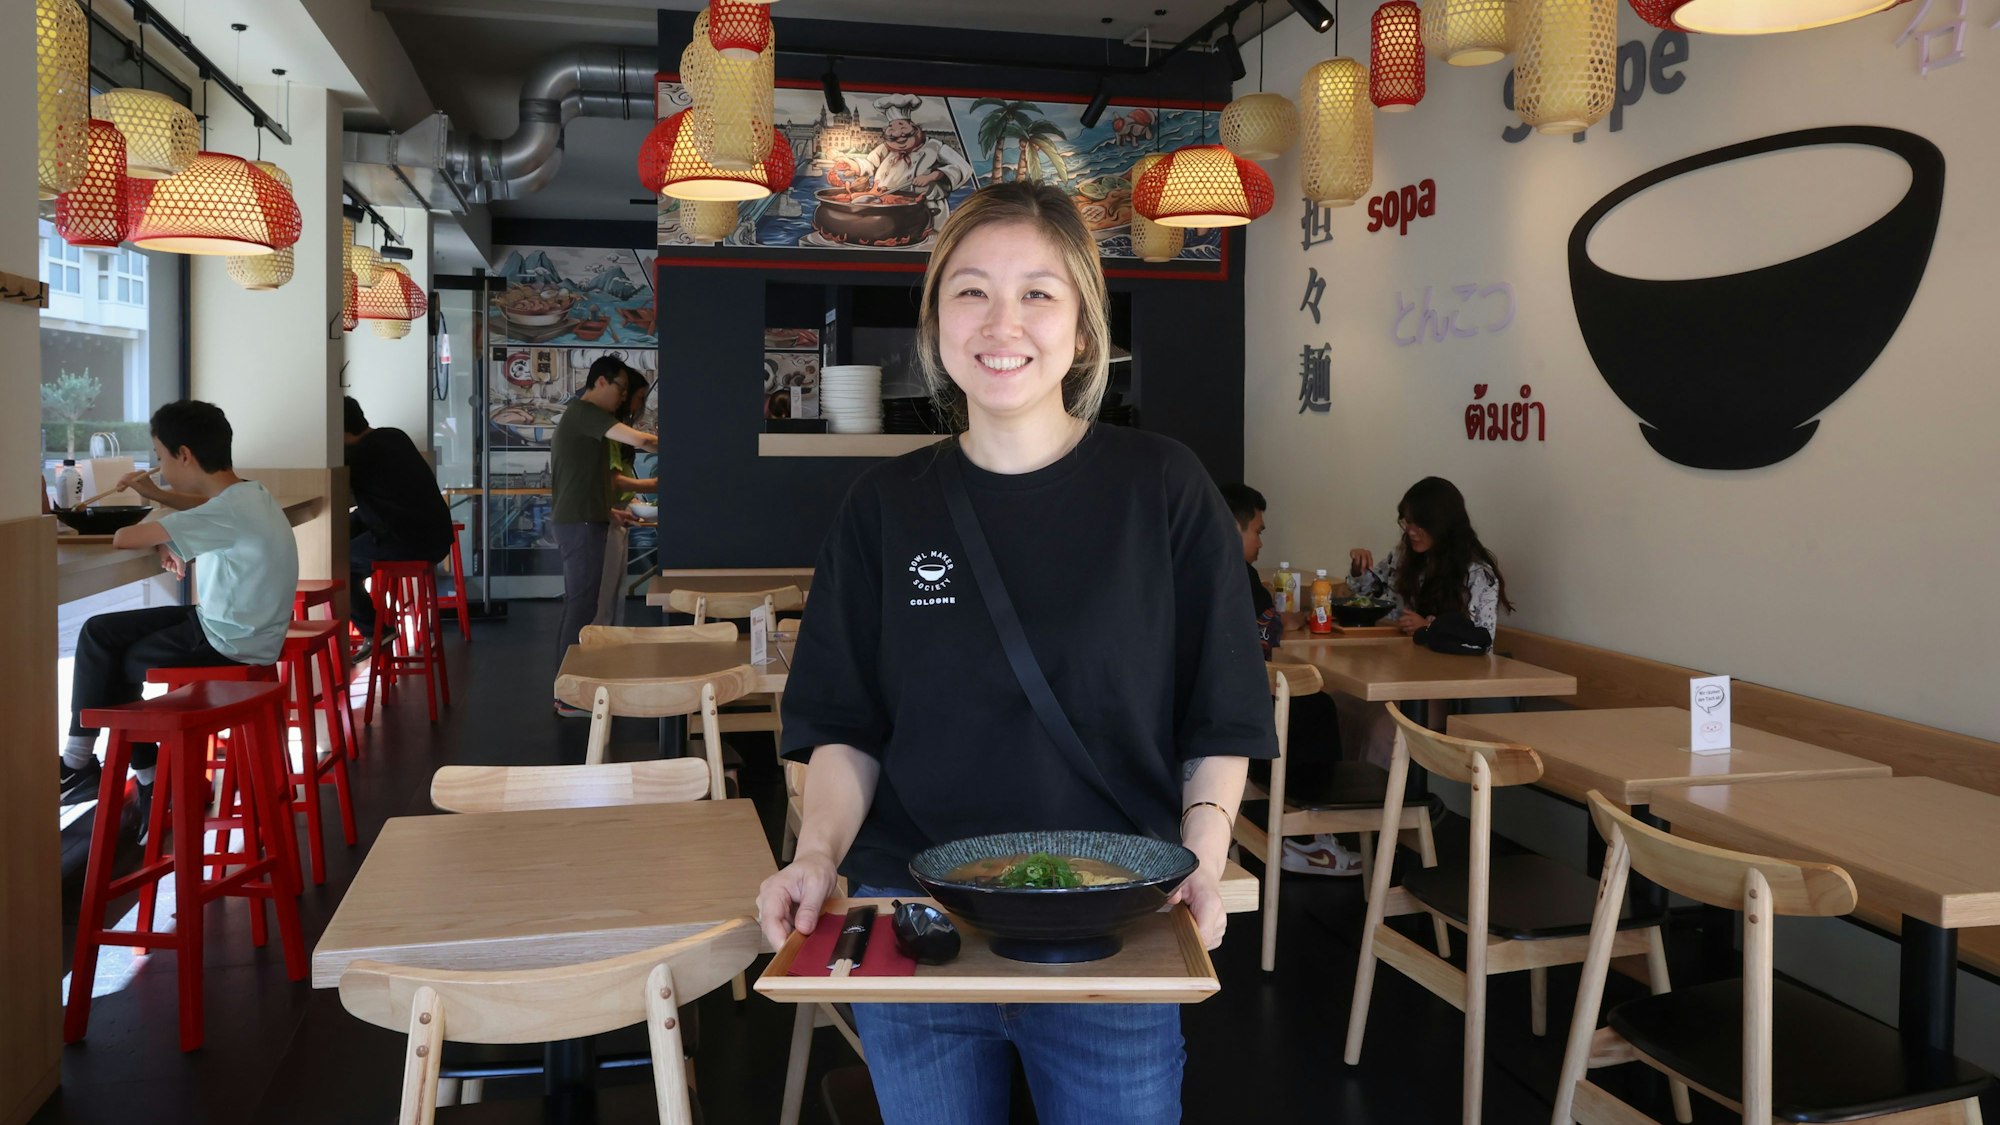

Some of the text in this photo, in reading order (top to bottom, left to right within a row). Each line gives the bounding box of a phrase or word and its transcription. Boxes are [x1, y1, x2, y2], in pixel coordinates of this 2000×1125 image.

[1366, 178, 1436, 236] sopa
[1388, 280, 1517, 348] とんこつ
[1464, 383, 1546, 442] ต้มยำ
[909, 551, 954, 572] BOWL MAKER
[910, 597, 956, 606] COLOGNE
[912, 578, 951, 592] SOCIETY
